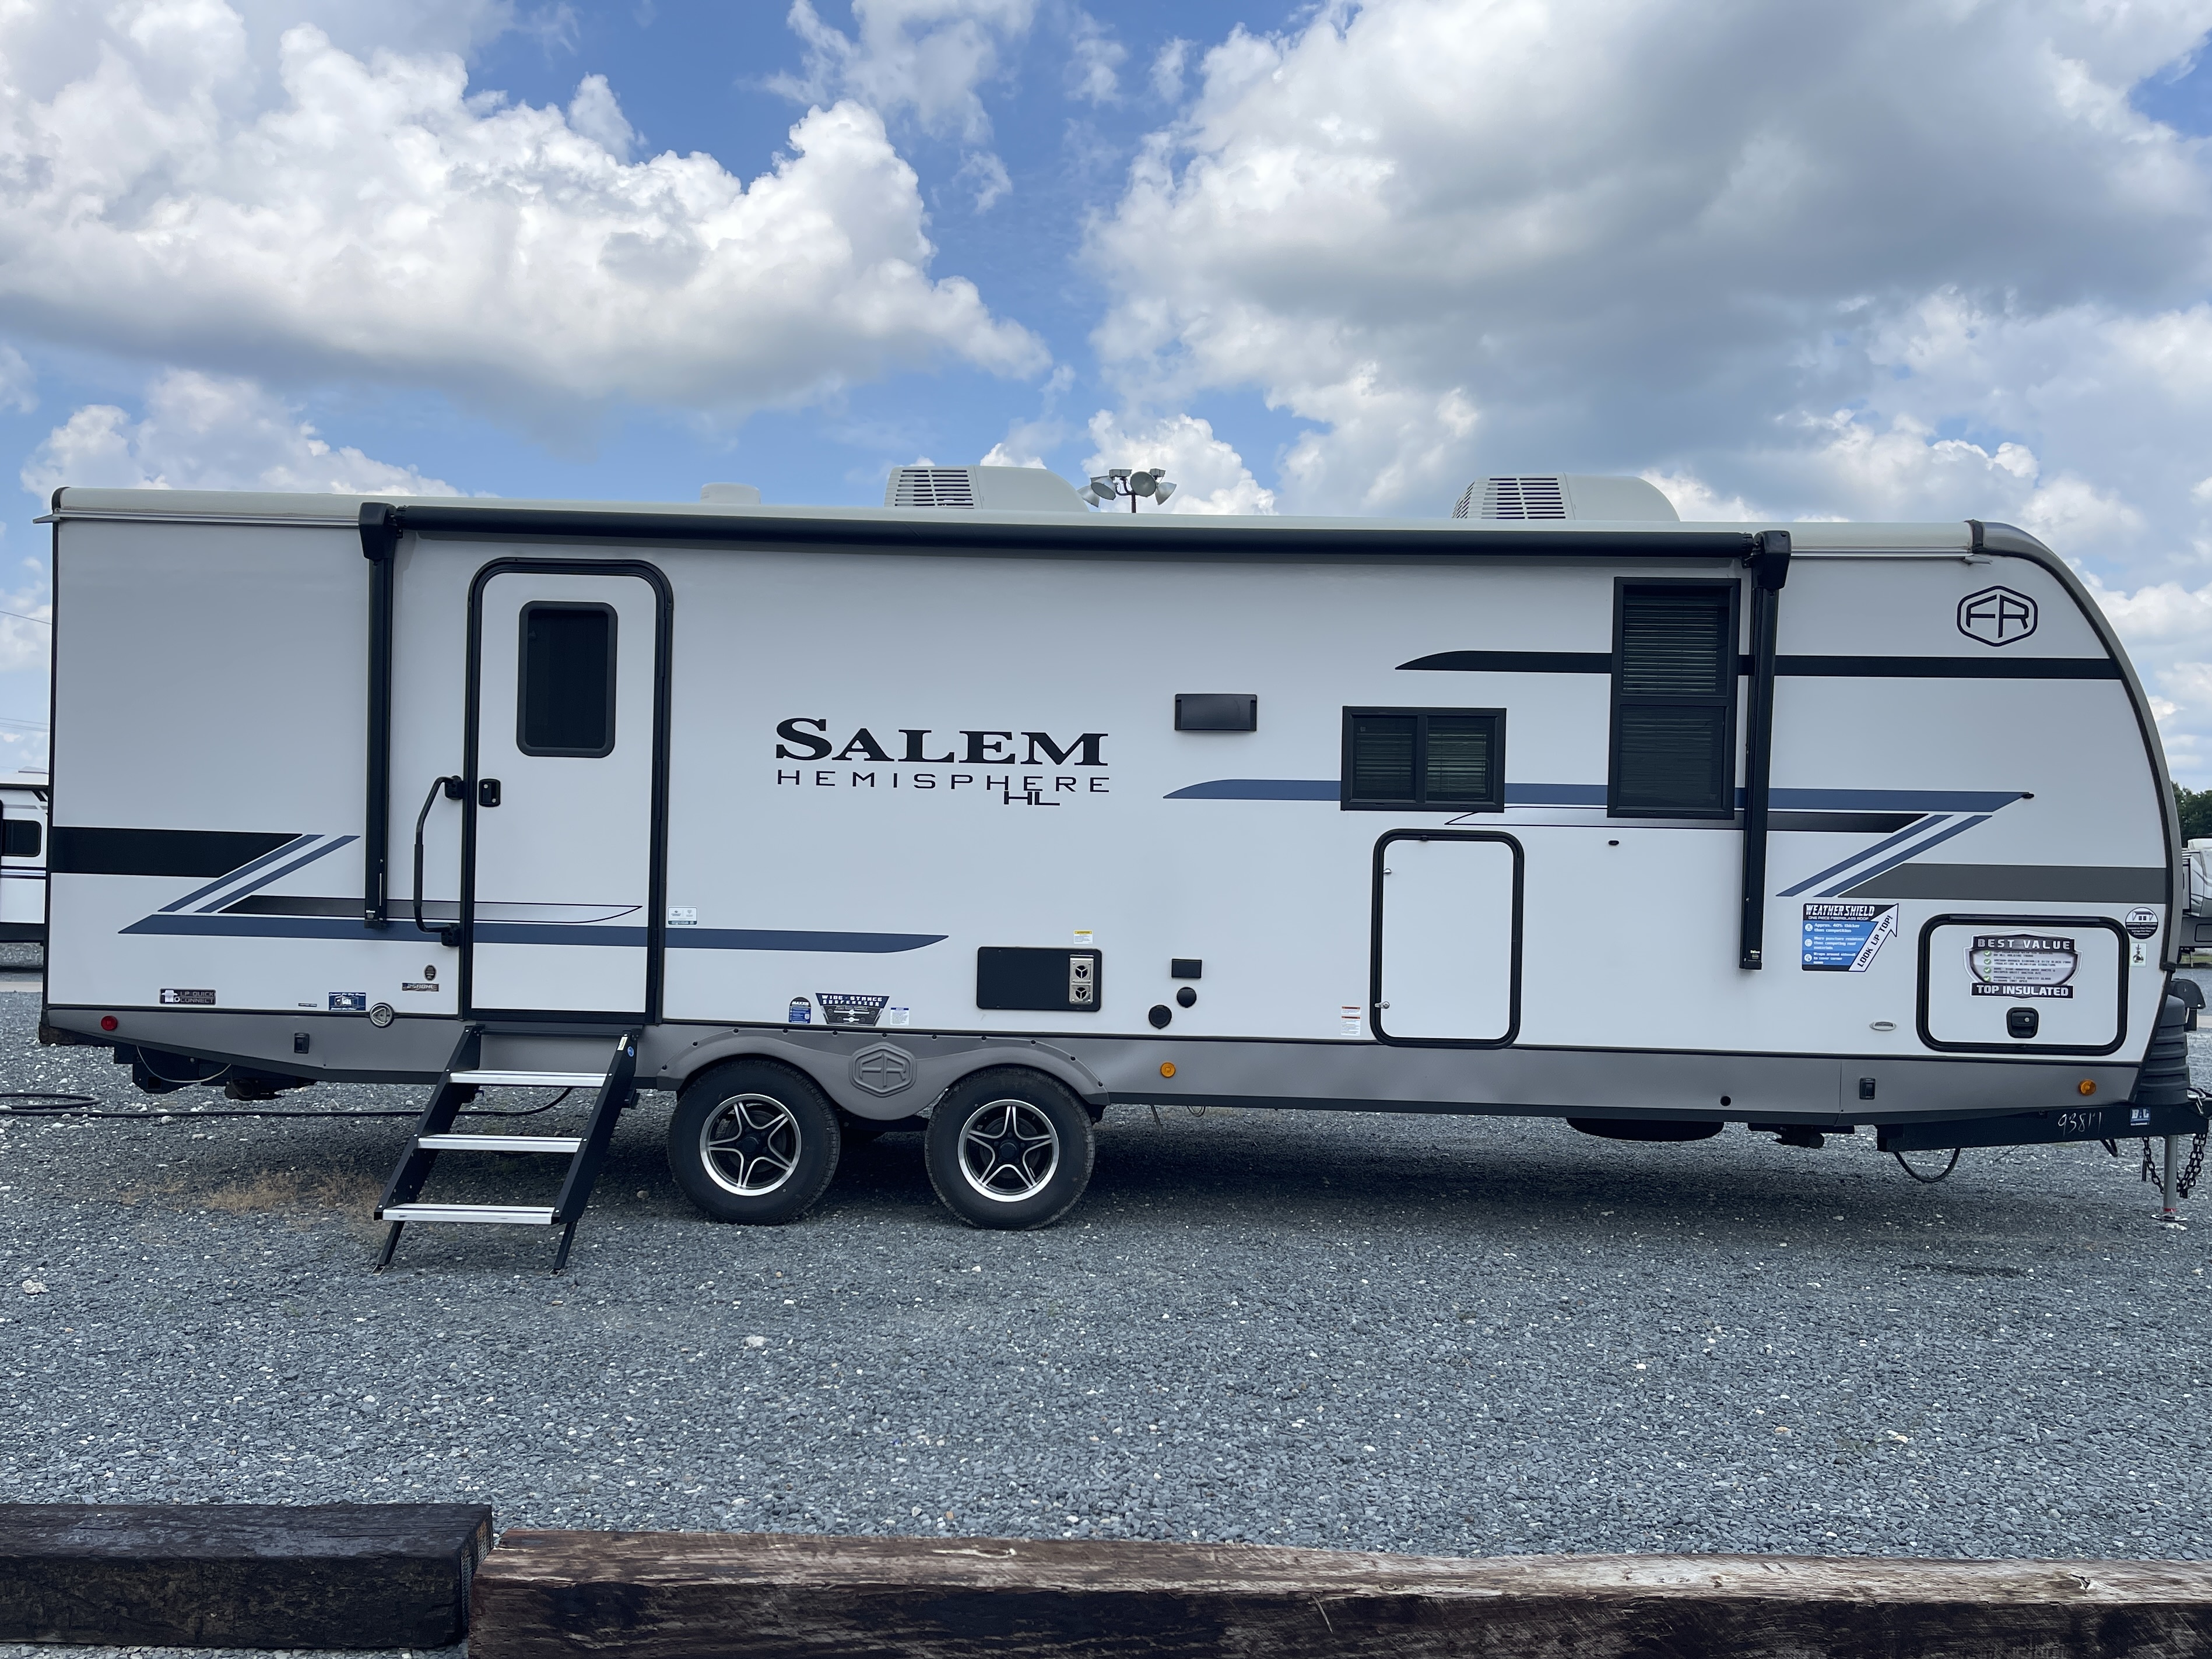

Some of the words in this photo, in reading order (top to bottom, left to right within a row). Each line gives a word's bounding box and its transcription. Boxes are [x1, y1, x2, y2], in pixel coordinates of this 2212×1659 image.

[776, 718, 1108, 765] SALEM
[777, 769, 1109, 793] HEMISPHERE
[1003, 790, 1061, 806] HL
[1858, 947, 1873, 967] LOOK
[1871, 934, 1880, 946] UP
[1879, 915, 1893, 933] TOP!
[1978, 939, 2015, 948] BEST
[2023, 940, 2070, 950] VALUE
[1976, 985, 2000, 994] TOP
[2003, 985, 2069, 996] INSULATED
